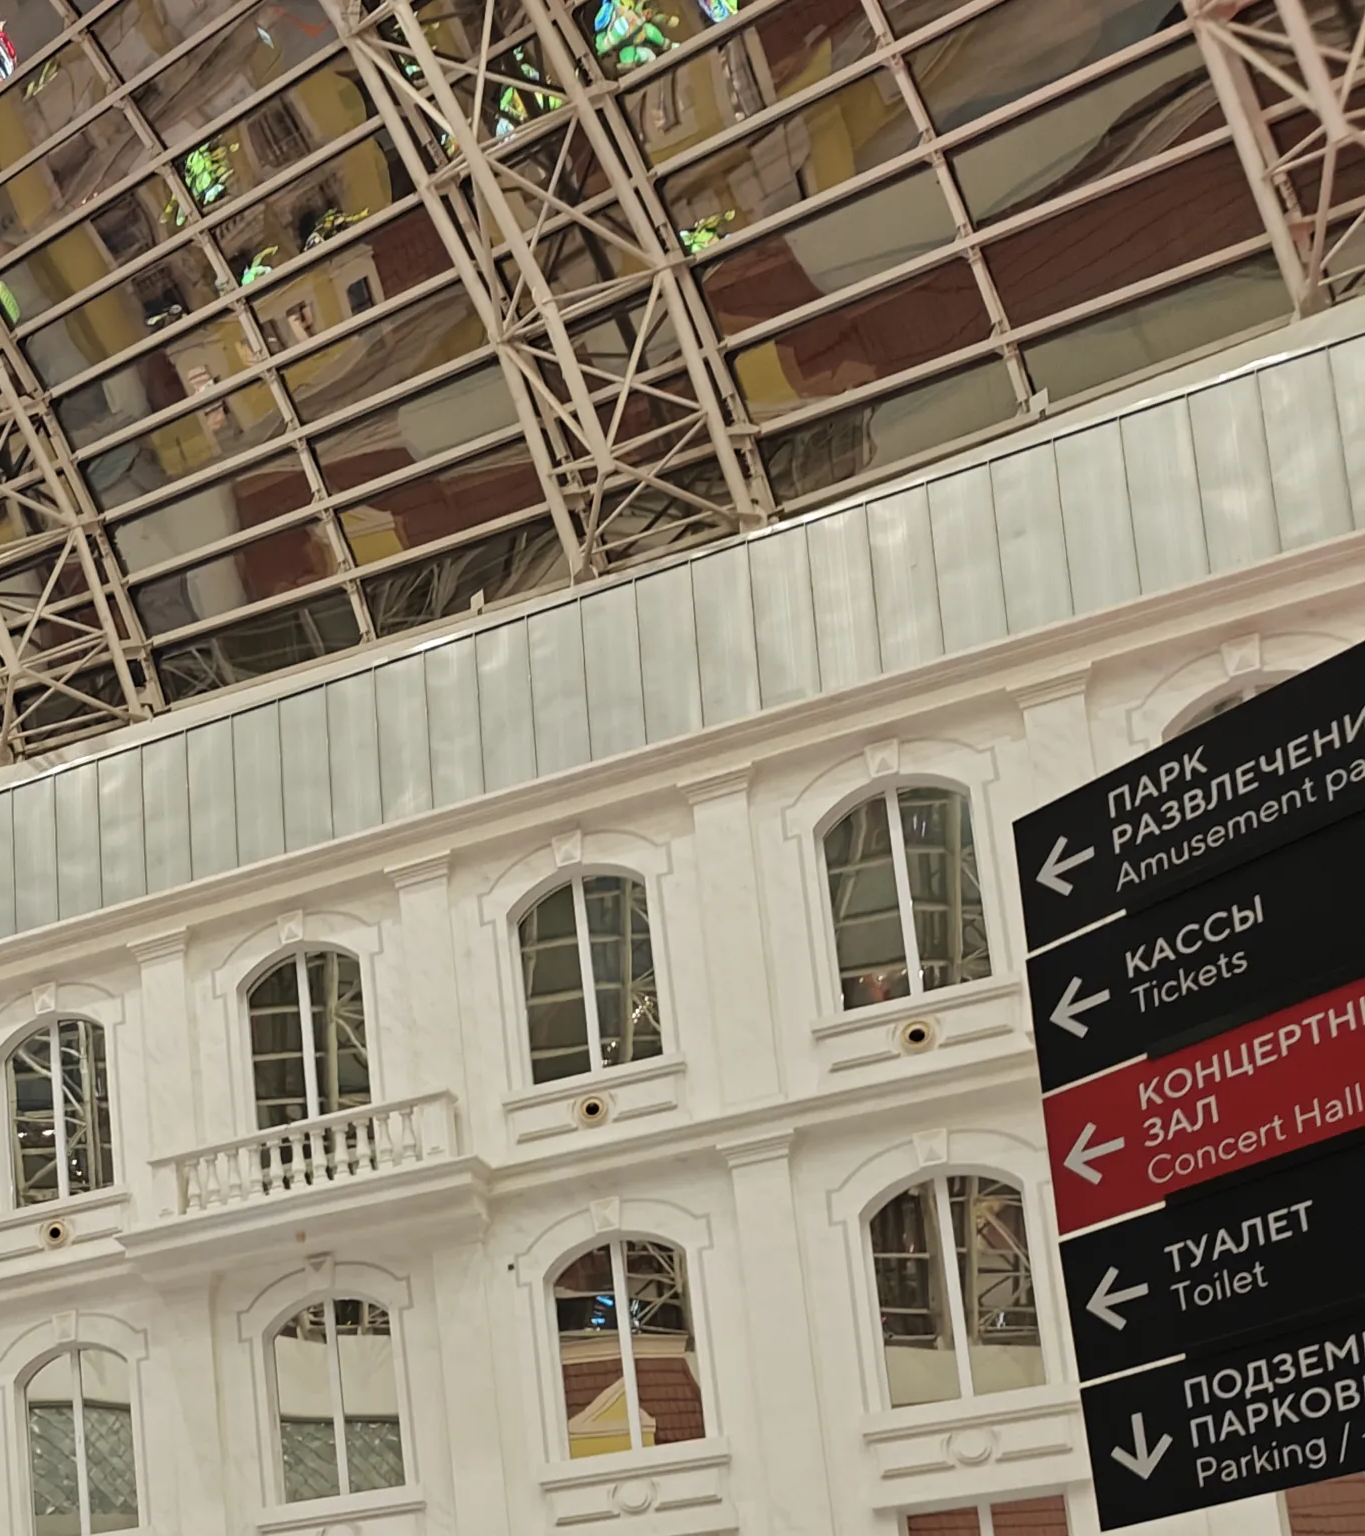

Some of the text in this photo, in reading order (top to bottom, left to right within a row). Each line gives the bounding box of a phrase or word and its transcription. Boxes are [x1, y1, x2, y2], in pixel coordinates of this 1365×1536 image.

[1107, 745, 1207, 818] ПАРК
[1115, 777, 1317, 893] Amusement
[1125, 895, 1264, 978] КАССЫ
[1130, 951, 1248, 1012] Tickets
[1142, 1095, 1219, 1147] ЗАЛ
[1147, 1082, 1364, 1184] Concert Hall
[1164, 1200, 1313, 1273] ТУАЛЕТ
[1170, 1261, 1268, 1312] Toilet
[1184, 1331, 1365, 1409] ПОДЗЕМ
[1190, 1374, 1365, 1448] ПАРКОВ
[1196, 1437, 1327, 1488] Parking
